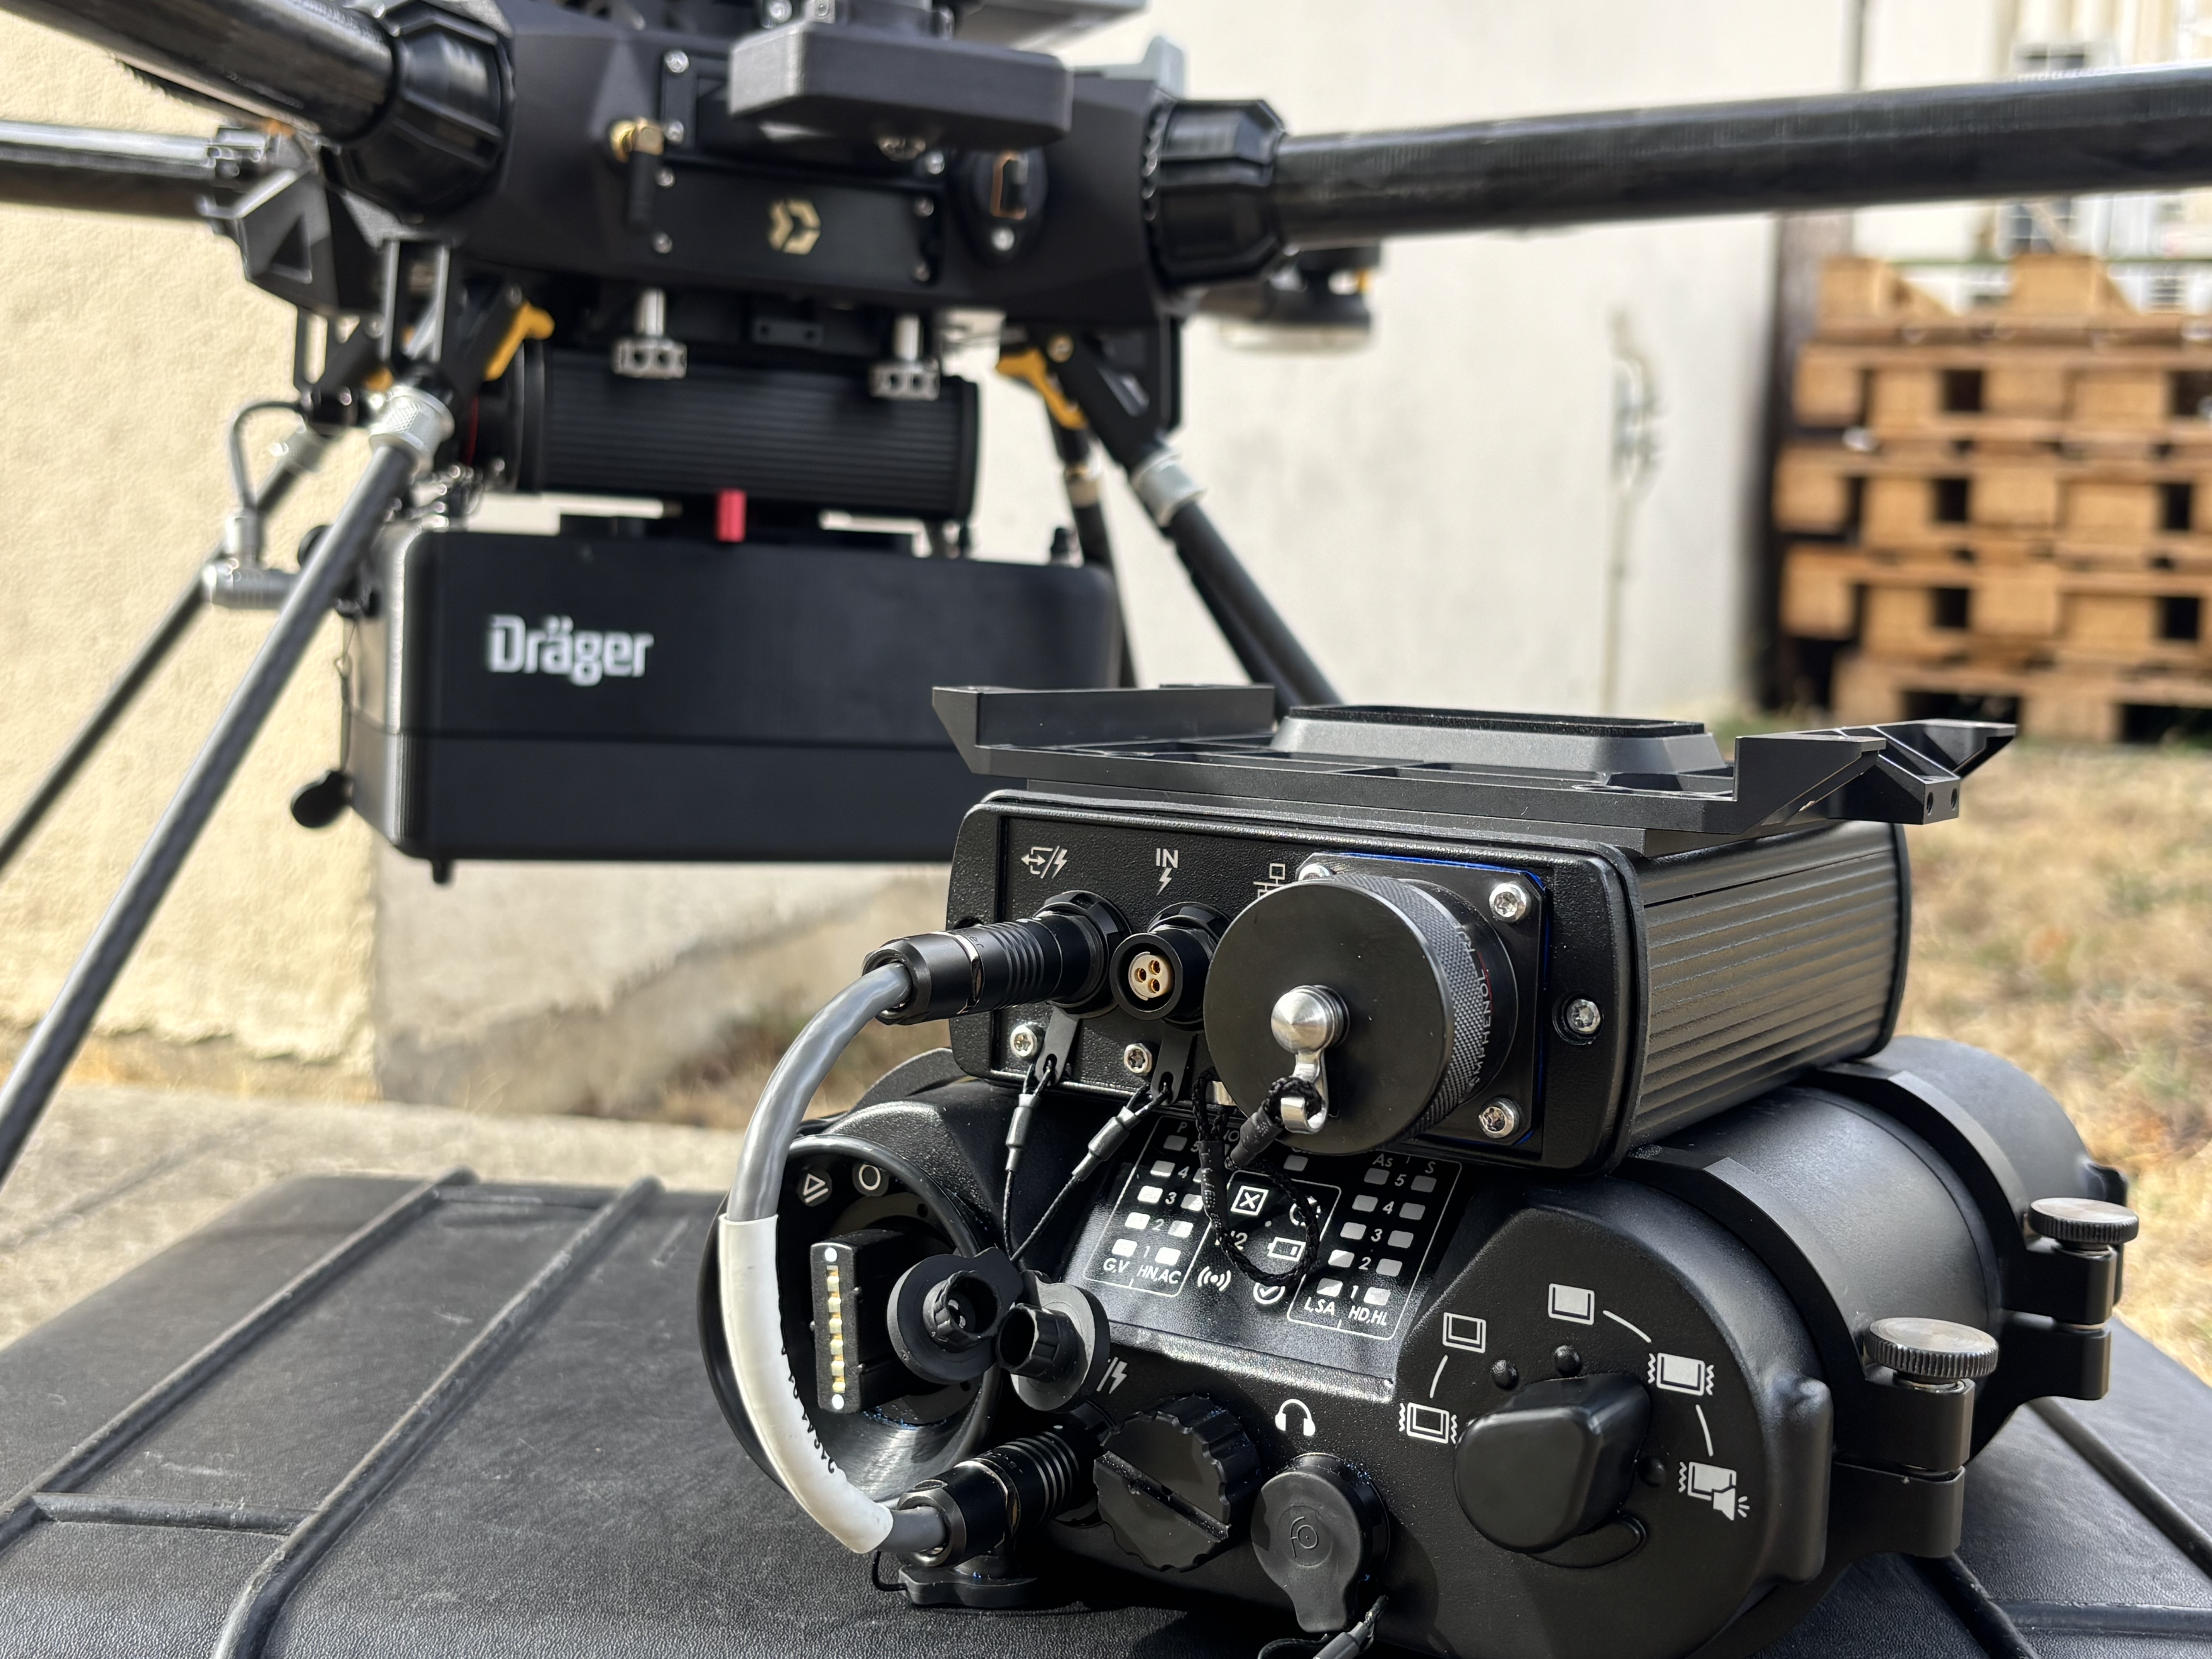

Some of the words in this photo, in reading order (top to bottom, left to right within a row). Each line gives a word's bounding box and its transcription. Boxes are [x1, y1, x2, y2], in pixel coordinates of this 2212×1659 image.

[486, 612, 654, 686] Dräger
[1156, 848, 1178, 868] IN
[1176, 1121, 1188, 1133] P
[1372, 1153, 1393, 1168] As
[1424, 1161, 1436, 1174] S
[1177, 1166, 1190, 1179] 4
[1394, 1174, 1407, 1187] 5
[1165, 1190, 1176, 1205] 3
[1382, 1201, 1395, 1214] 4
[1152, 1218, 1164, 1231] 2
[1370, 1228, 1383, 1242] 3
[1143, 1245, 1151, 1258] 1
[1358, 1256, 1372, 1270] 2
[1103, 1257, 1130, 1273] G,V
[1136, 1264, 1182, 1284] HN,AC
[1350, 1285, 1359, 1299] 1
[1304, 1296, 1335, 1315] L,SA
[1348, 1305, 1388, 1326] HD,HL
